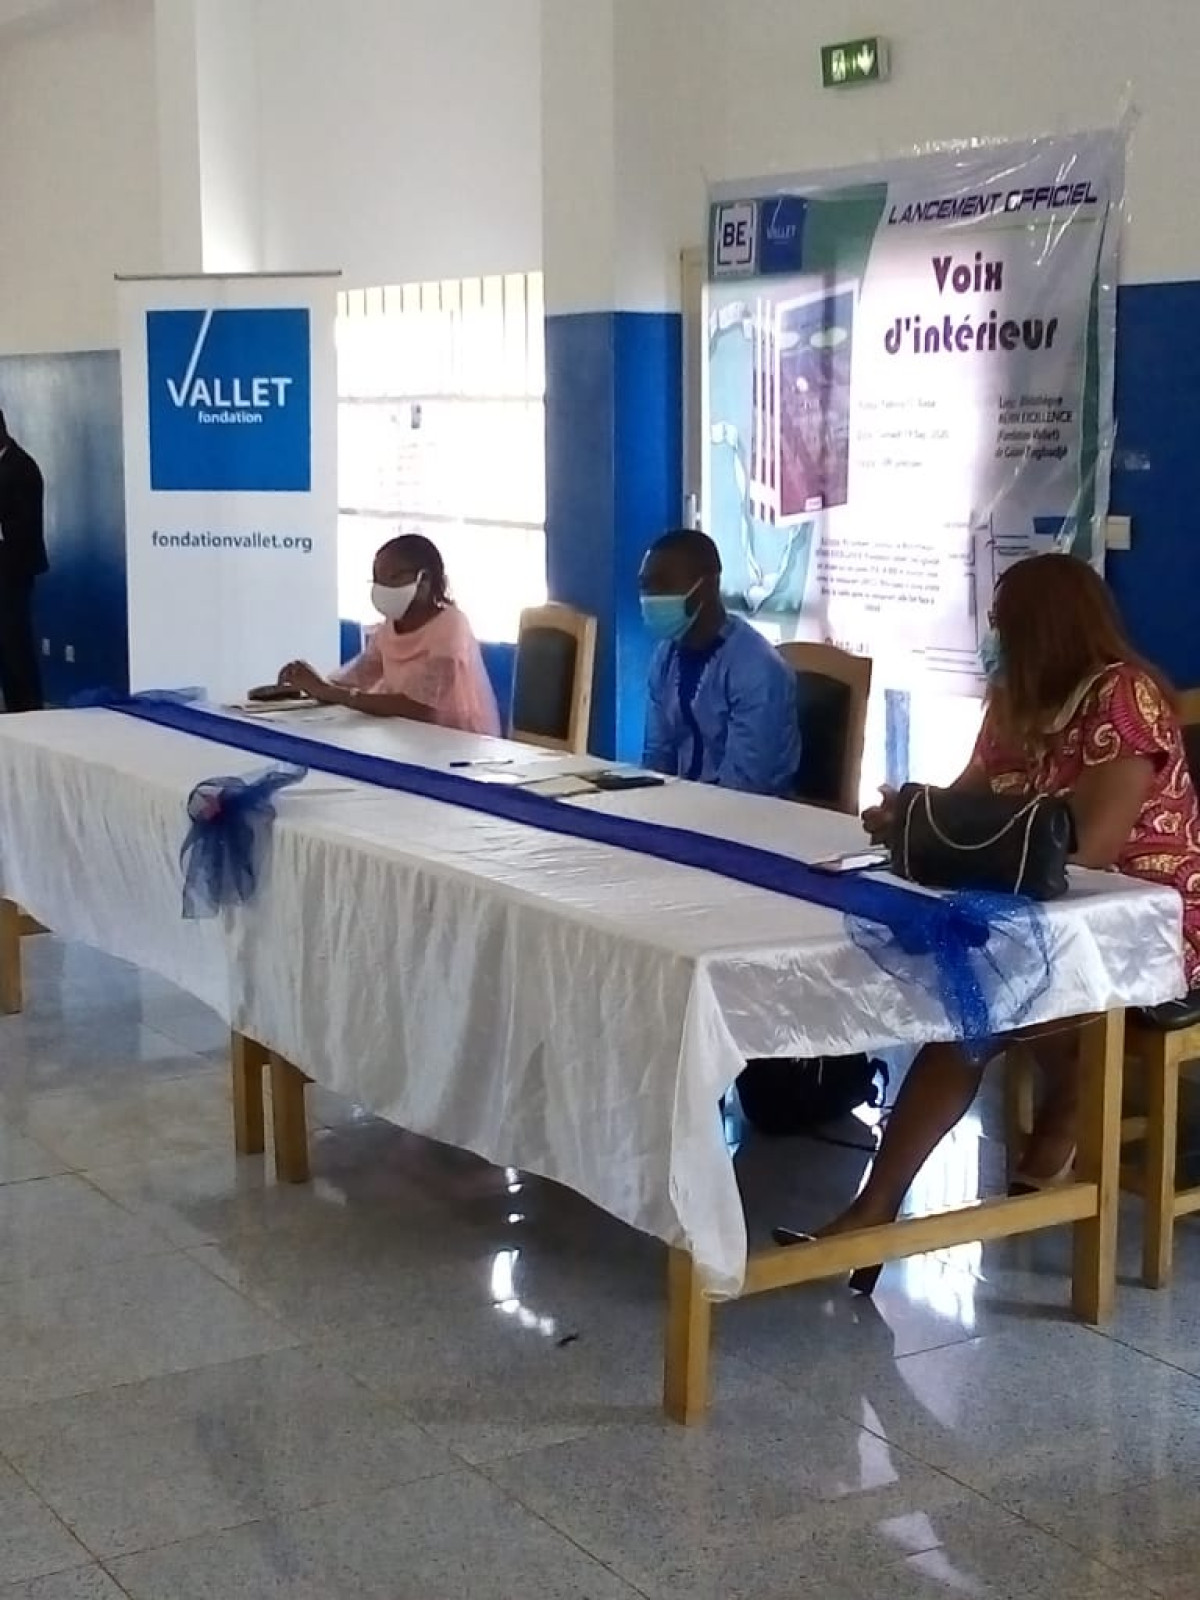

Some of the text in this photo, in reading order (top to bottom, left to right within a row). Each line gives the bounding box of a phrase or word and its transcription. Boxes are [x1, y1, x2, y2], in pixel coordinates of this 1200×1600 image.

[888, 181, 1098, 225] LANCEMENT OFFICIEL
[722, 220, 748, 248] BE
[932, 251, 1004, 295] Voix
[885, 309, 1059, 355] d'intérieur
[198, 410, 264, 424] fondation
[151, 530, 313, 553] fondationvallet.org
